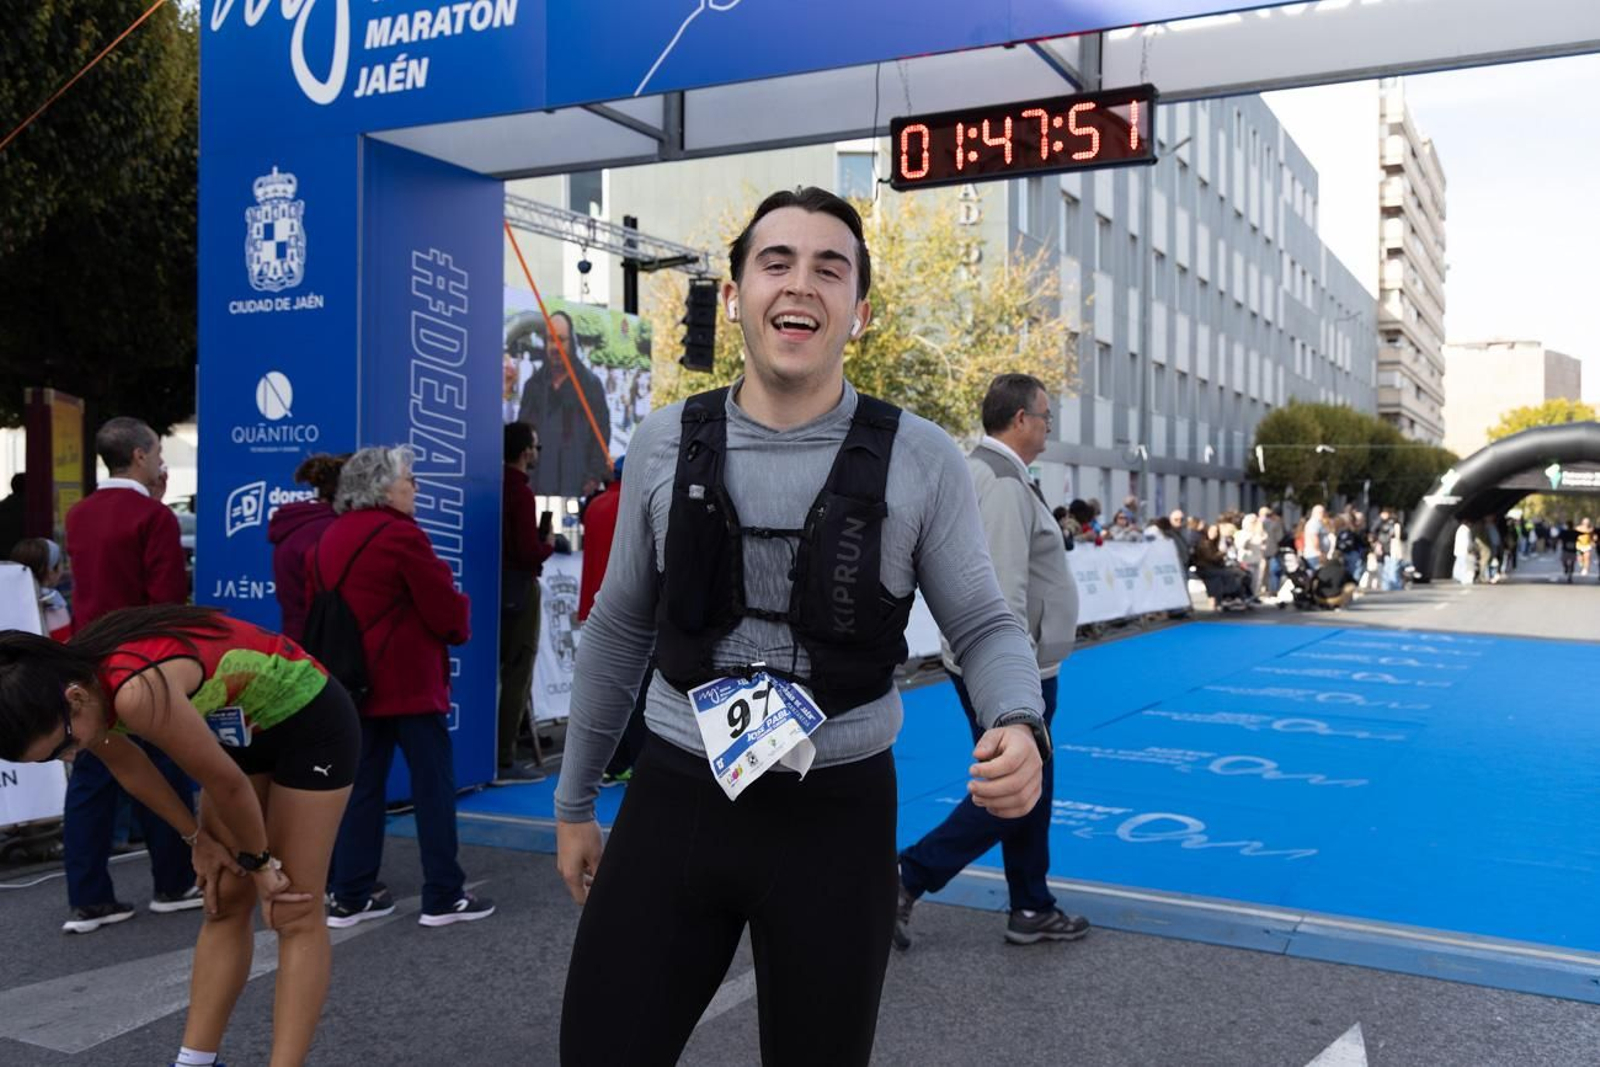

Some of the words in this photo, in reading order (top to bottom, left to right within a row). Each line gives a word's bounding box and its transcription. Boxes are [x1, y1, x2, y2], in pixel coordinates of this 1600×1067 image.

[354, 54, 429, 98] JAÉN
[229, 299, 273, 315] CIUDAD
[274, 297, 291, 311] DE
[292, 292, 324, 310] JAÉN
[832, 517, 867, 634] KIPRUN
